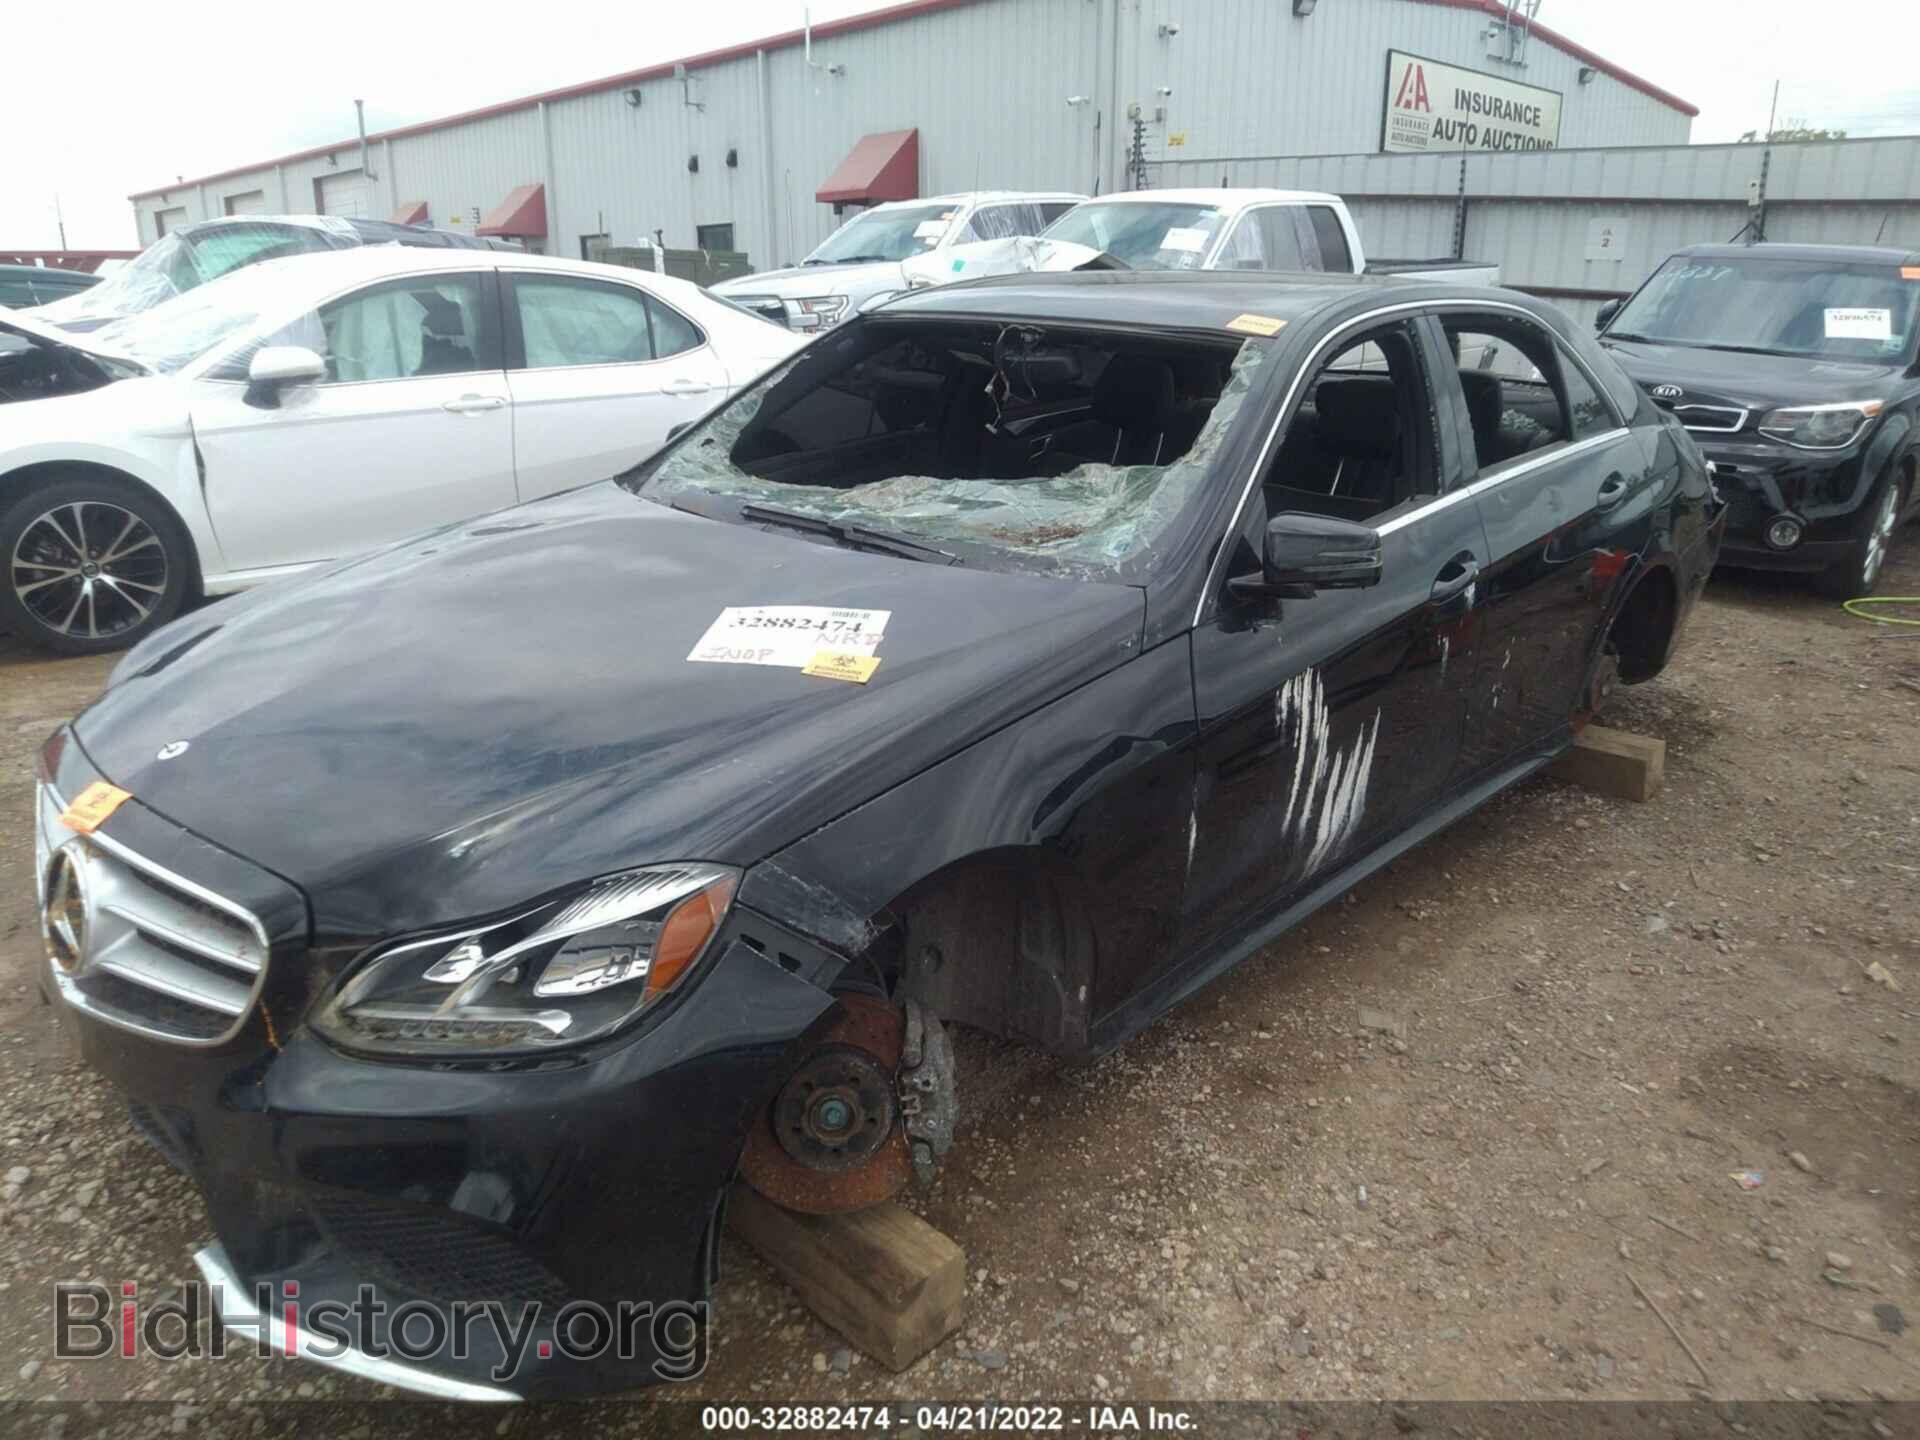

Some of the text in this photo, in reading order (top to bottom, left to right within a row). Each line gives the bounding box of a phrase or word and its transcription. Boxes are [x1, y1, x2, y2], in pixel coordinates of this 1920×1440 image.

[1454, 87, 1542, 128] INSURANCE
[1432, 117, 1478, 146] AUTO
[1654, 385, 1680, 397] KIA
[728, 616, 863, 633] 32882474
